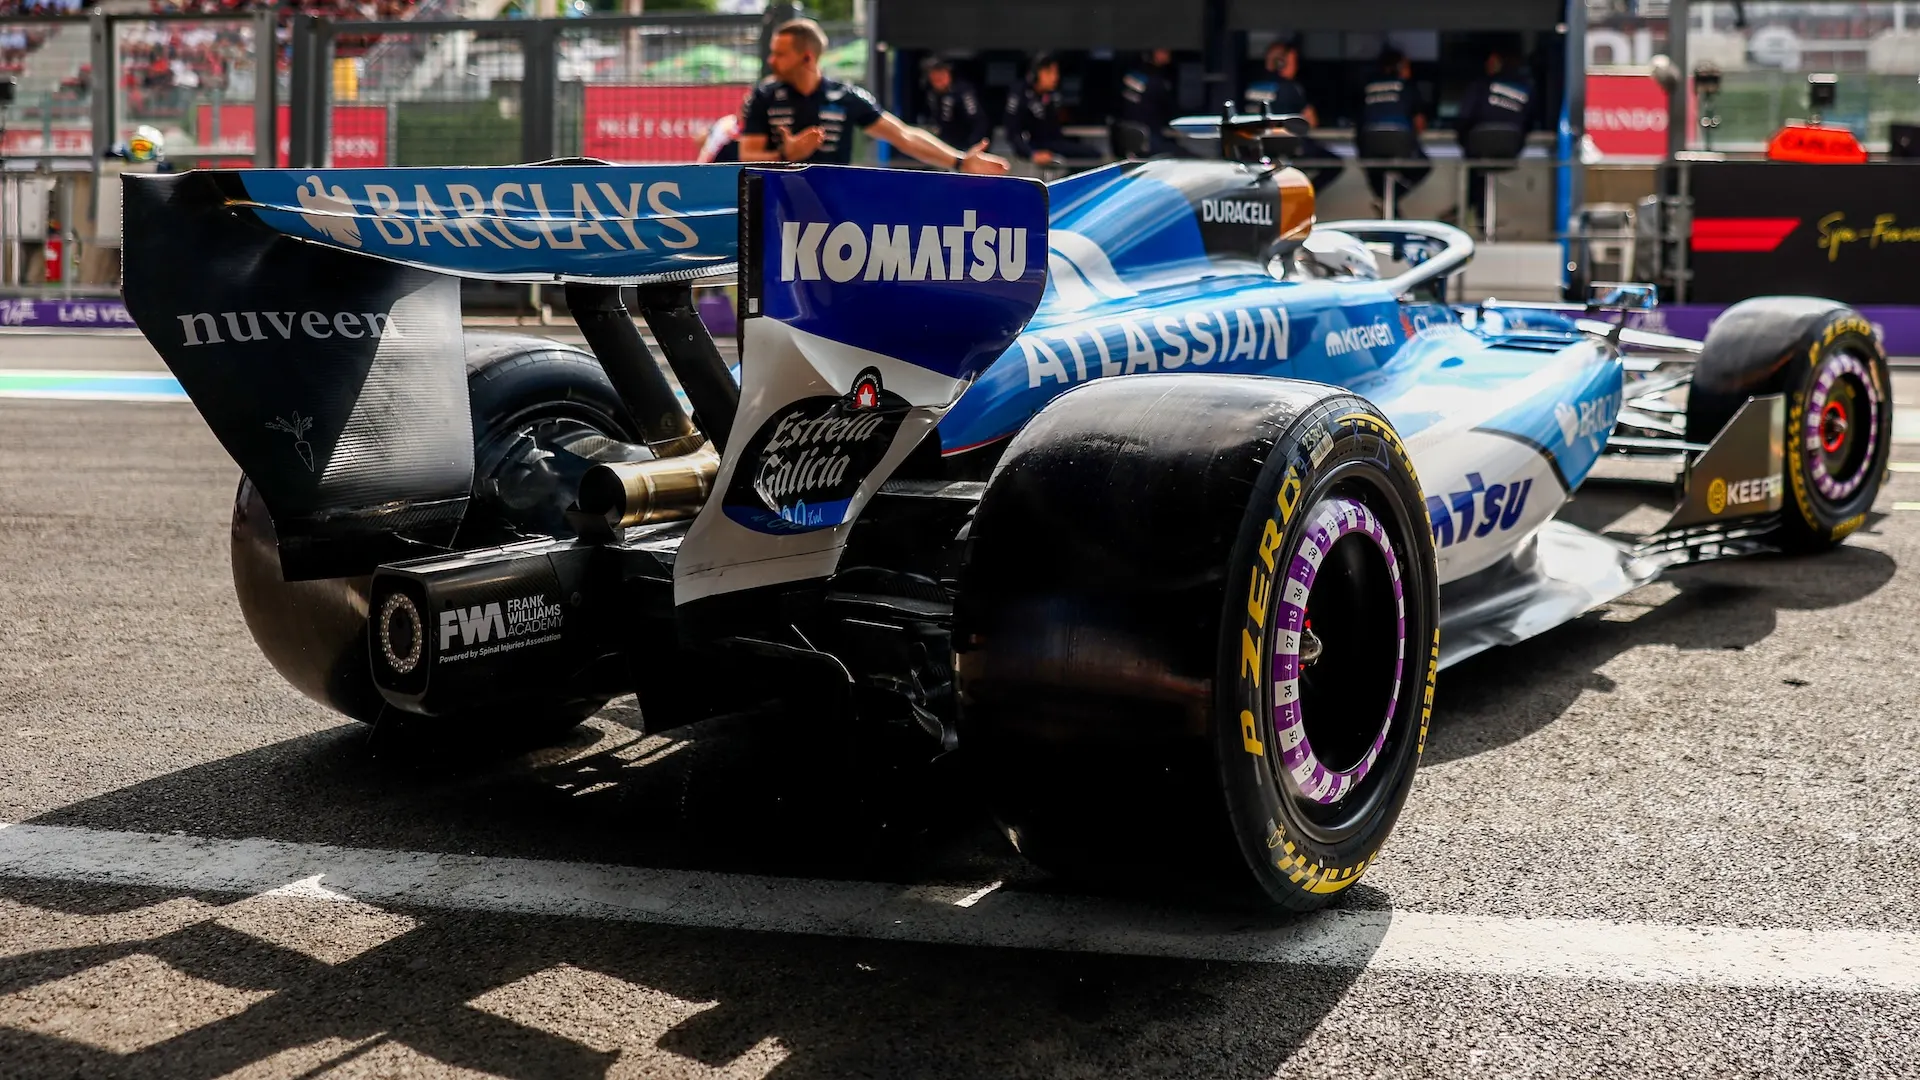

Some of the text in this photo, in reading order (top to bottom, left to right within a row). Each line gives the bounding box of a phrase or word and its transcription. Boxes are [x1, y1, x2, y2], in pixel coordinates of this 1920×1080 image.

[364, 181, 699, 250] BARCLAYS
[1201, 199, 1273, 226] DURACELL
[781, 210, 1027, 283] KOMATSU
[177, 311, 405, 346] nuveen
[1016, 307, 1290, 388] ATLASSIAN
[763, 411, 884, 454] Estrella
[756, 445, 850, 498] Galicia
[1326, 519, 1336, 531] 23
[1308, 547, 1318, 560] 30
[1301, 566, 1310, 578] 11
[507, 594, 544, 613] FRANK
[1293, 587, 1303, 601] 36
[507, 604, 561, 625] WILLIAMS
[1240, 466, 1302, 757] P ZERO
[1288, 610, 1298, 623] 13
[507, 615, 564, 637] ACADEMY
[439, 633, 562, 664] Powered by Spinal Injuries Association
[1285, 635, 1294, 649] 27
[1284, 684, 1292, 698] 34
[1285, 709, 1294, 722] 17
[1289, 730, 1298, 743] 25
